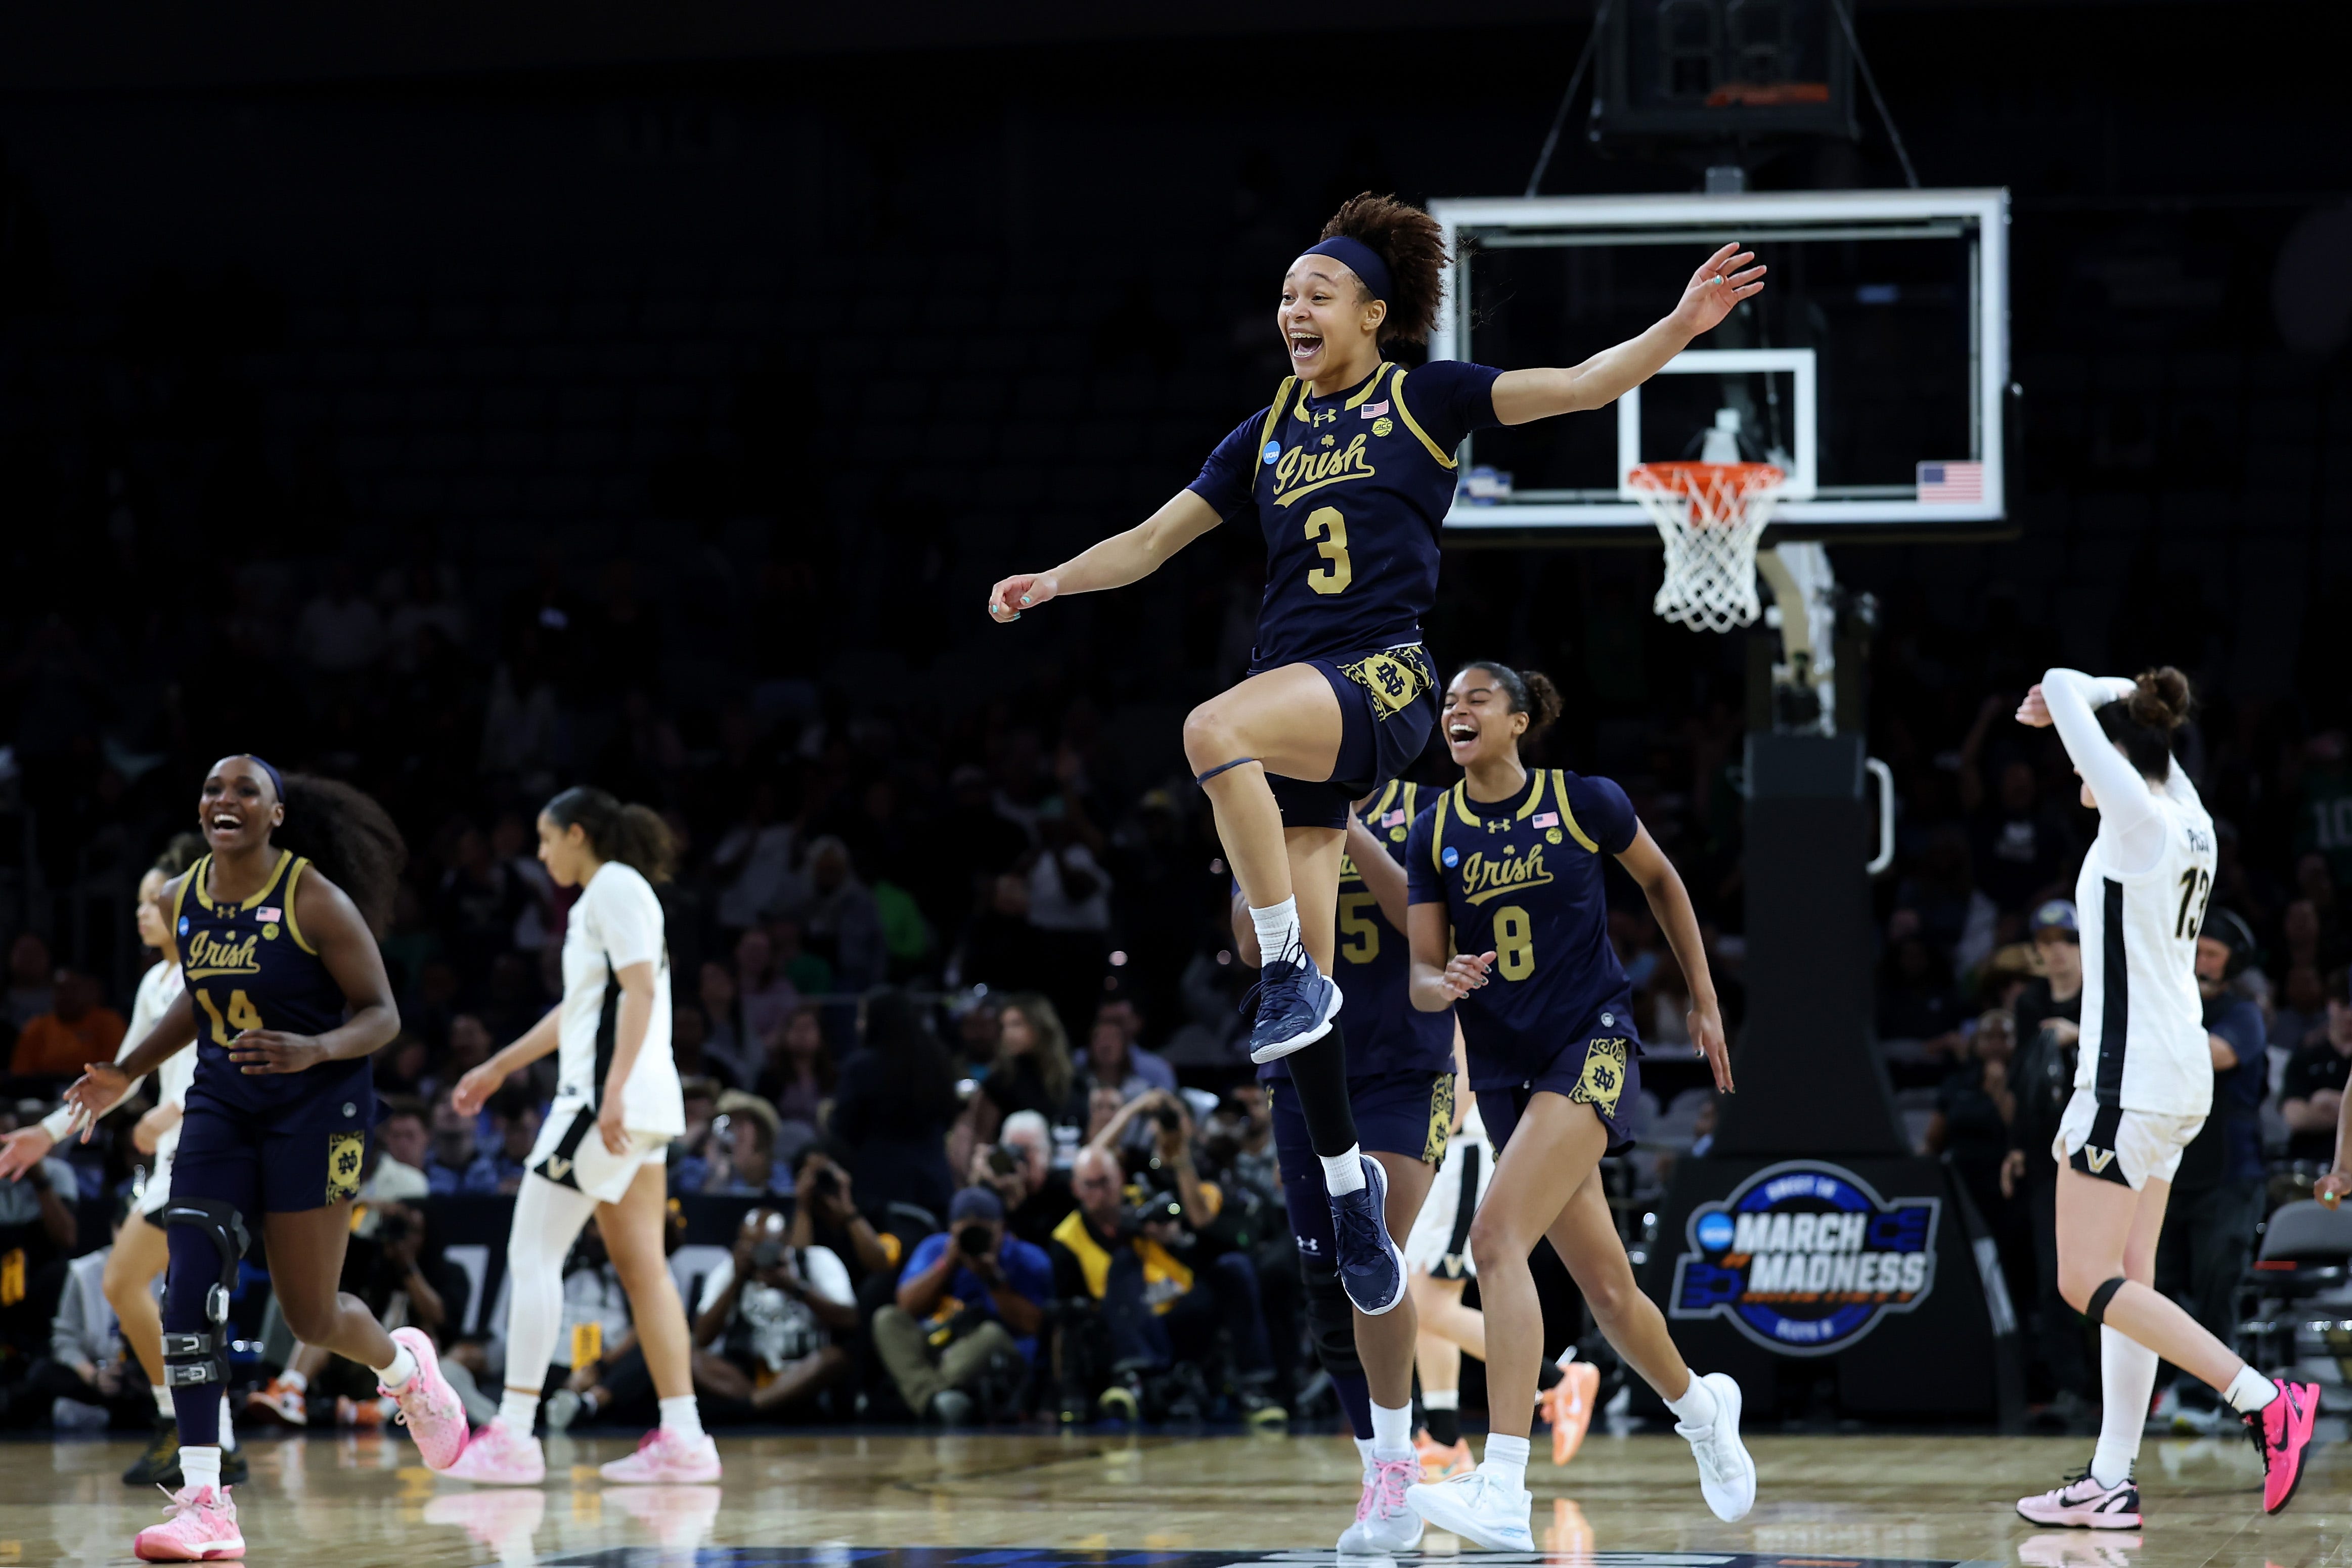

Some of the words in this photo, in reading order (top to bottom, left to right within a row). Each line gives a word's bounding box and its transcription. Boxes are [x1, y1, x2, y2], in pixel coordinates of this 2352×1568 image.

[1273, 433, 1375, 496] Irish
[1305, 507, 1351, 594] 3
[1462, 843, 1554, 895] Irish
[1338, 891, 1380, 964] 5
[2175, 866, 2209, 940] 13
[186, 929, 261, 970] Irish
[1493, 905, 1535, 981] 8
[195, 988, 263, 1048] 14
[2083, 1143, 2115, 1174] V
[1734, 1212, 1868, 1253] MARCH
[1748, 1251, 1926, 1293] MADNESS
